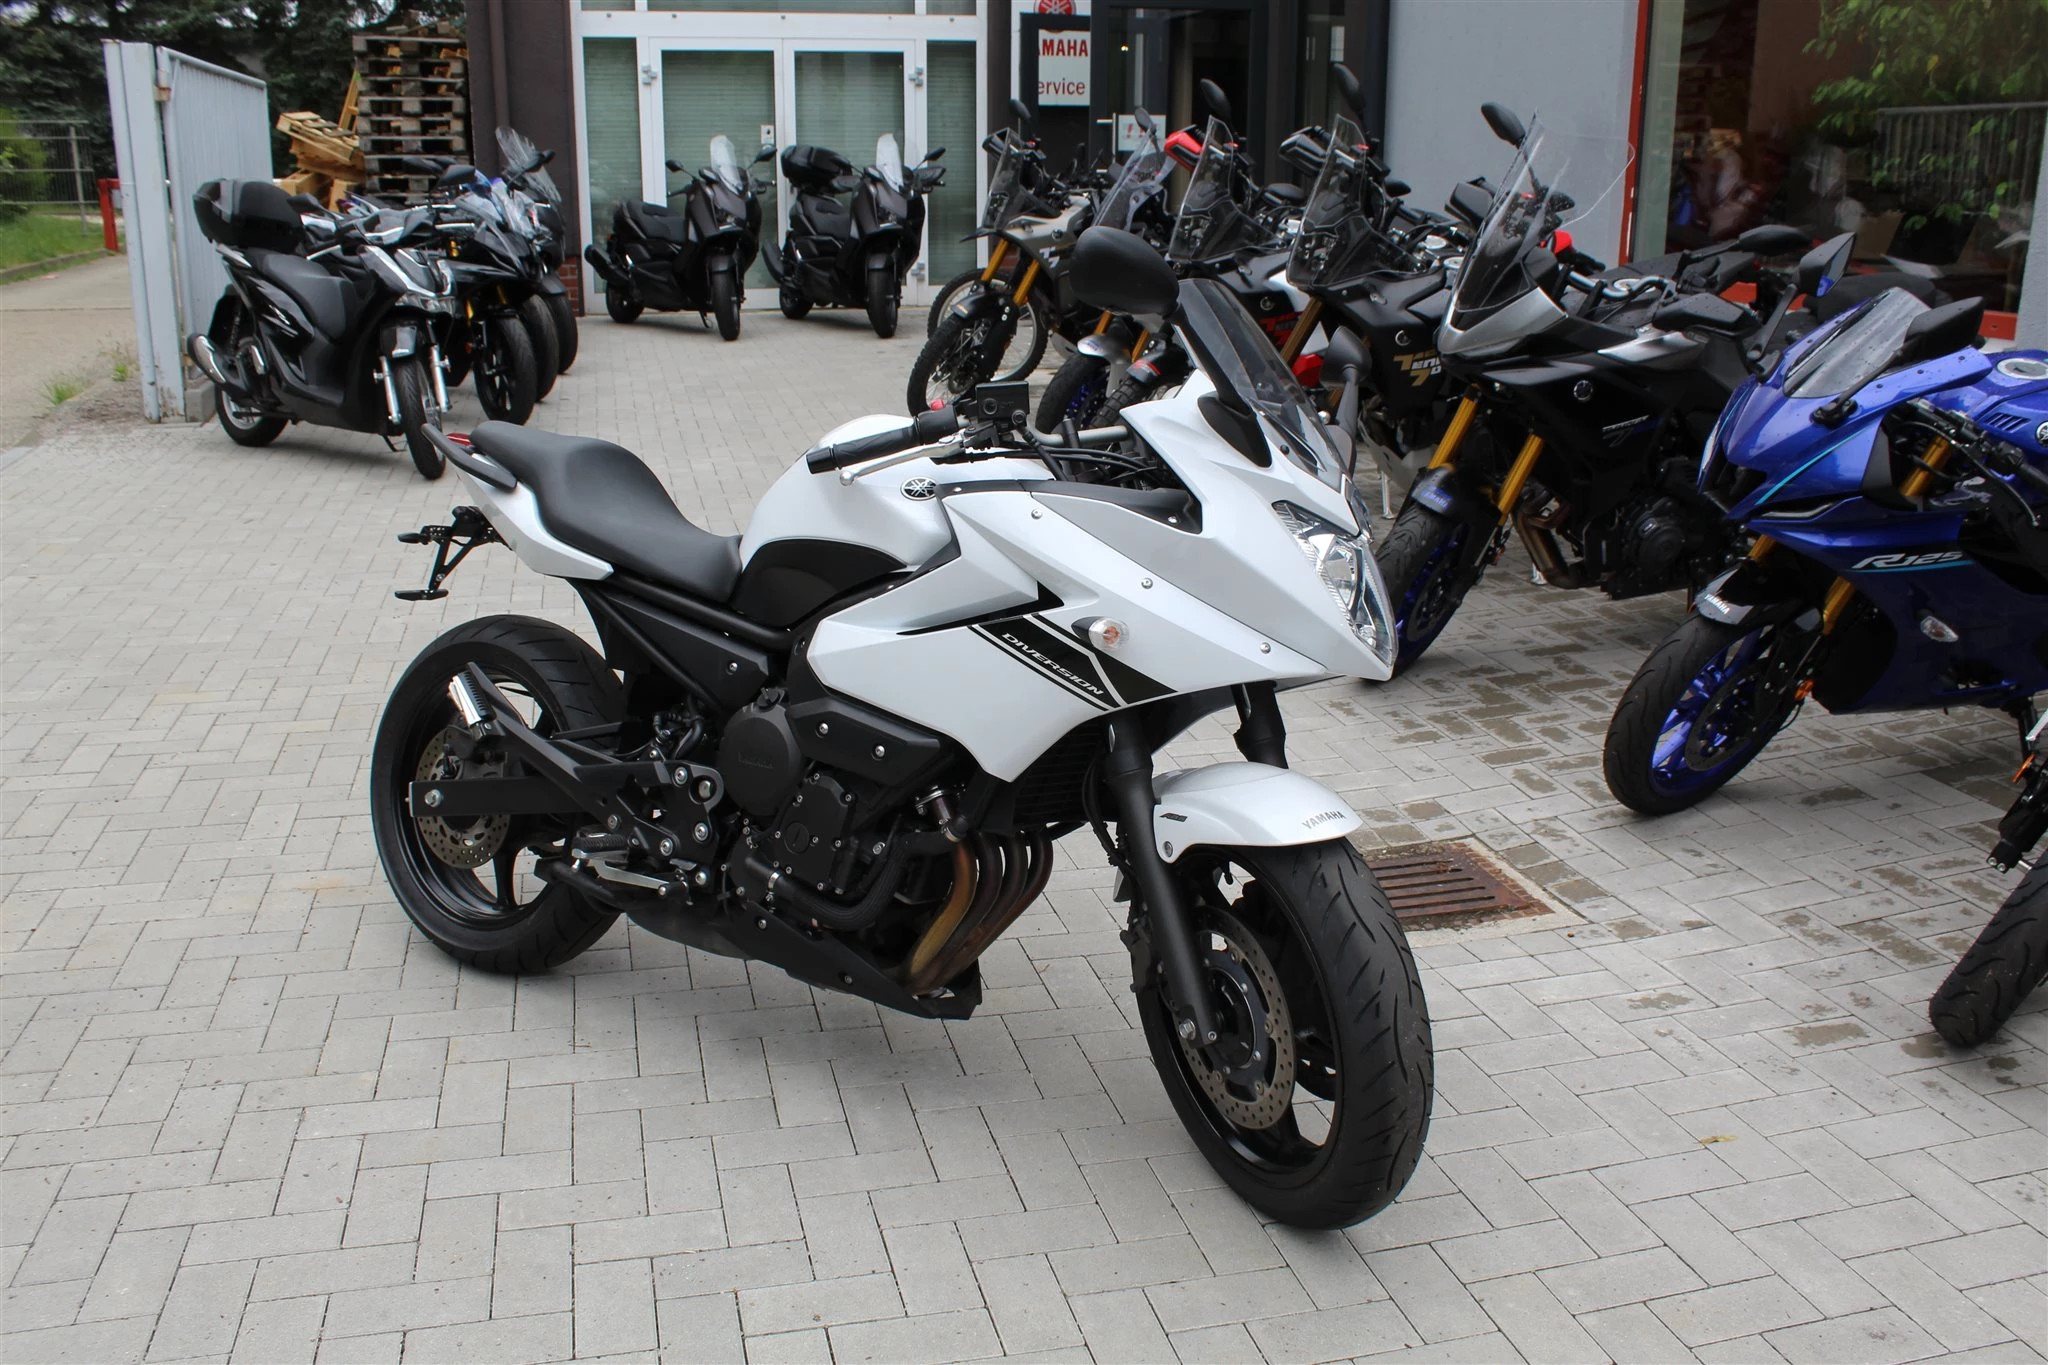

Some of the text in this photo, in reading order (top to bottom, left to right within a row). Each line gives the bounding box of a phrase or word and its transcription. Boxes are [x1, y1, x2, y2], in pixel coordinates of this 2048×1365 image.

[1038, 39, 1089, 57] MAHA
[1001, 632, 1105, 695] DIVERSION
[1302, 810, 1347, 830] YAMAHA
